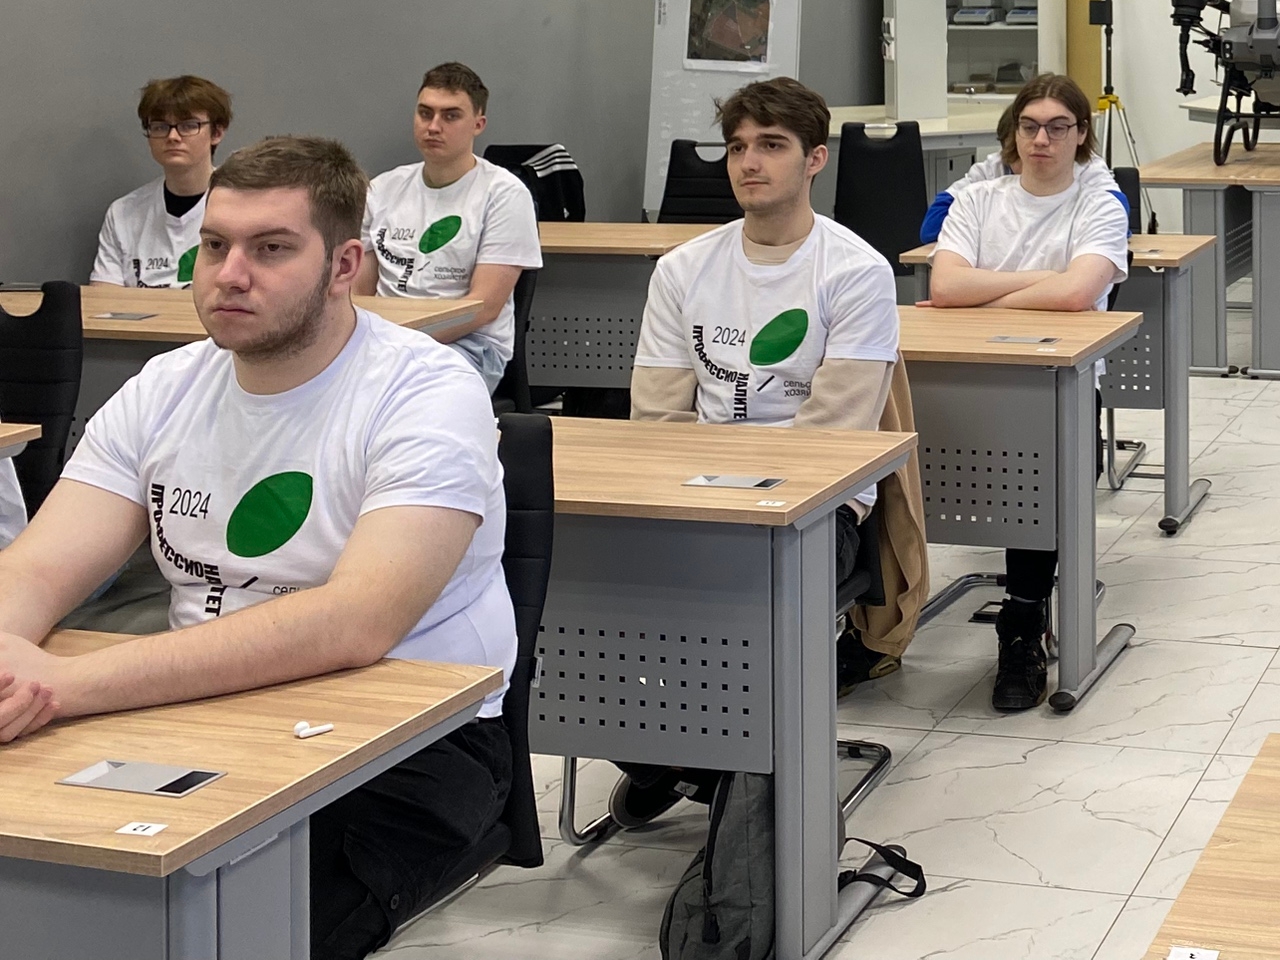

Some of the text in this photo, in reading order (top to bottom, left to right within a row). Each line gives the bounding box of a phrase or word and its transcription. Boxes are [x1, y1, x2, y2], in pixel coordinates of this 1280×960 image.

[391, 227, 416, 241] 2024
[712, 325, 747, 347] 2024
[169, 487, 212, 520] 2024
